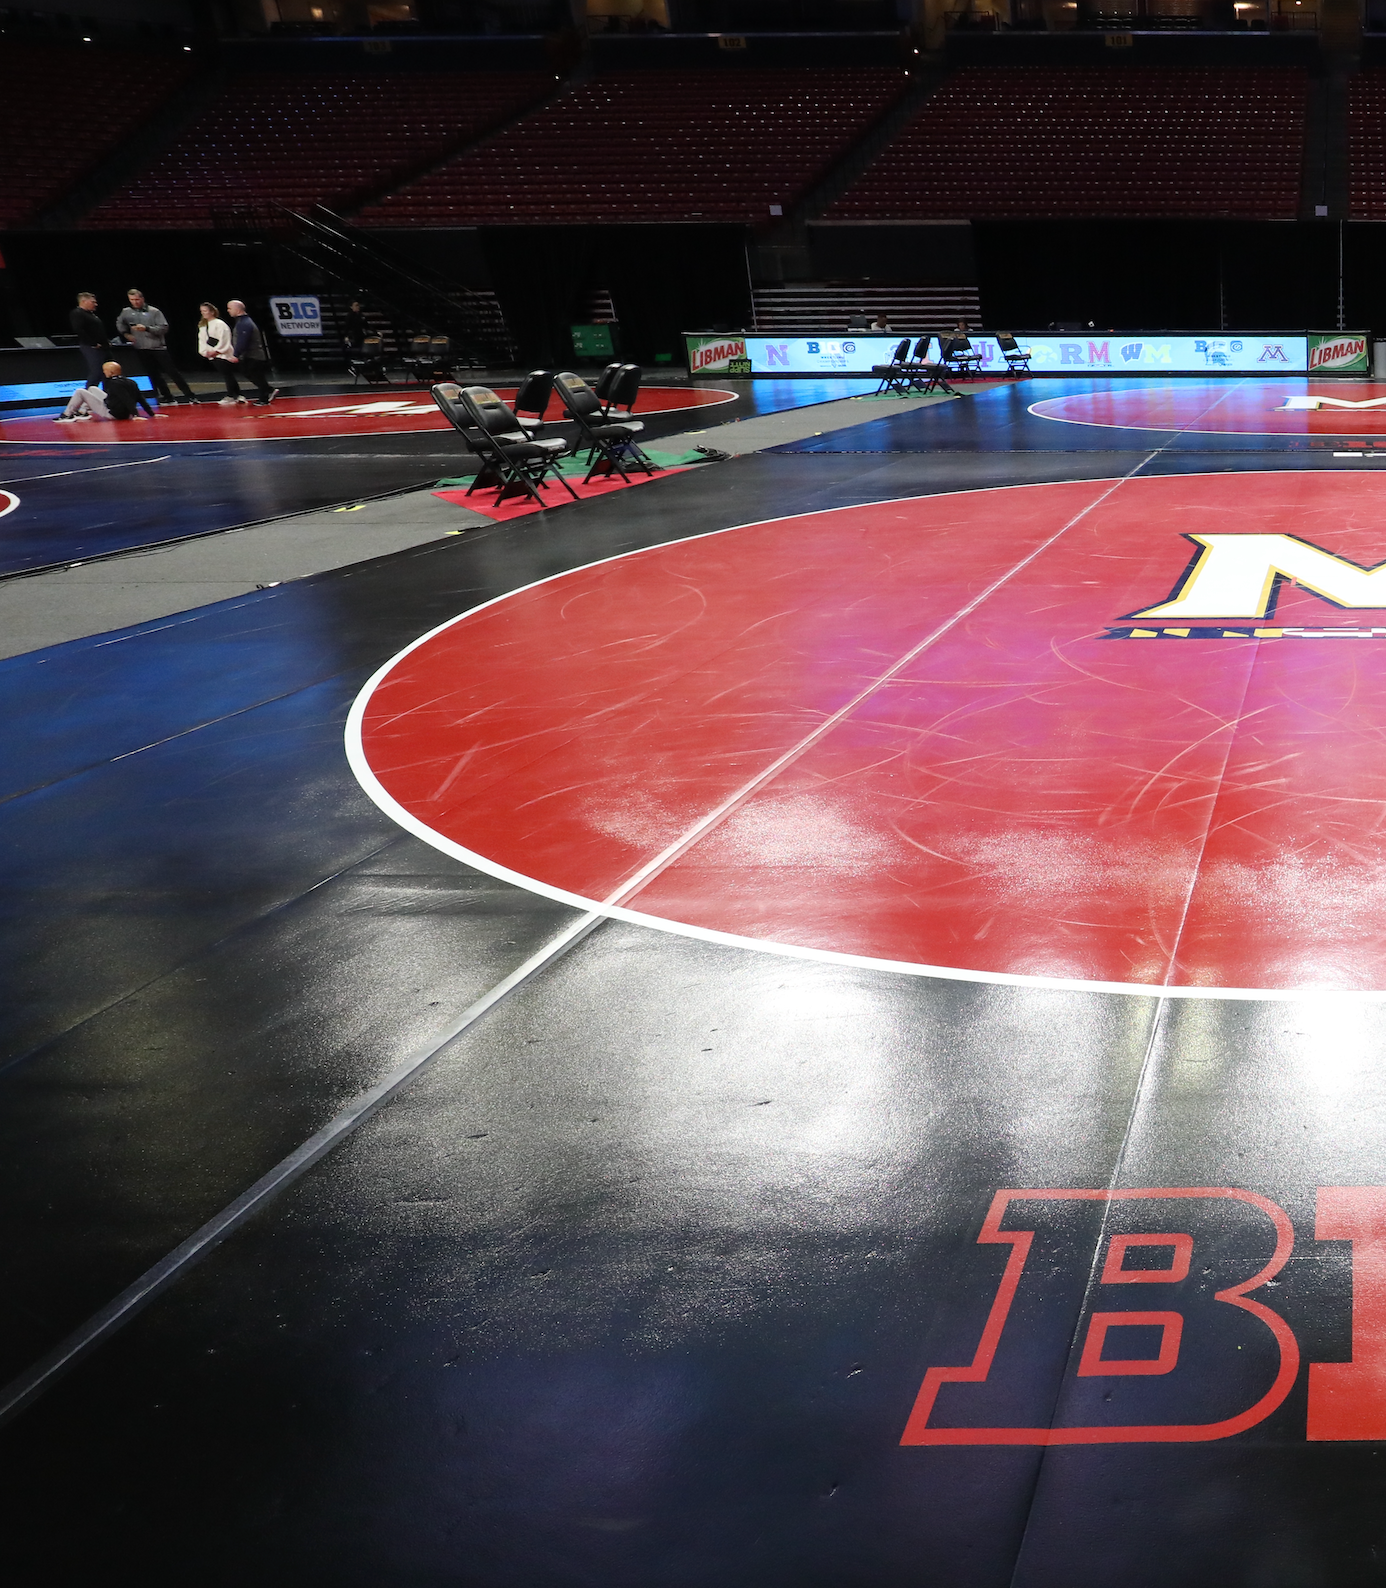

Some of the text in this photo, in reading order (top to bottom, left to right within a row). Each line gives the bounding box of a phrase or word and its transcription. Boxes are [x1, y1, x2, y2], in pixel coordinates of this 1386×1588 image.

[692, 342, 744, 371] LIBMAN
[766, 345, 789, 366] N
[1059, 344, 1084, 364] R
[1087, 342, 1111, 364] M
[1143, 345, 1172, 363] M
[1257, 345, 1289, 363] M
[1309, 340, 1365, 369] LIBMAN
